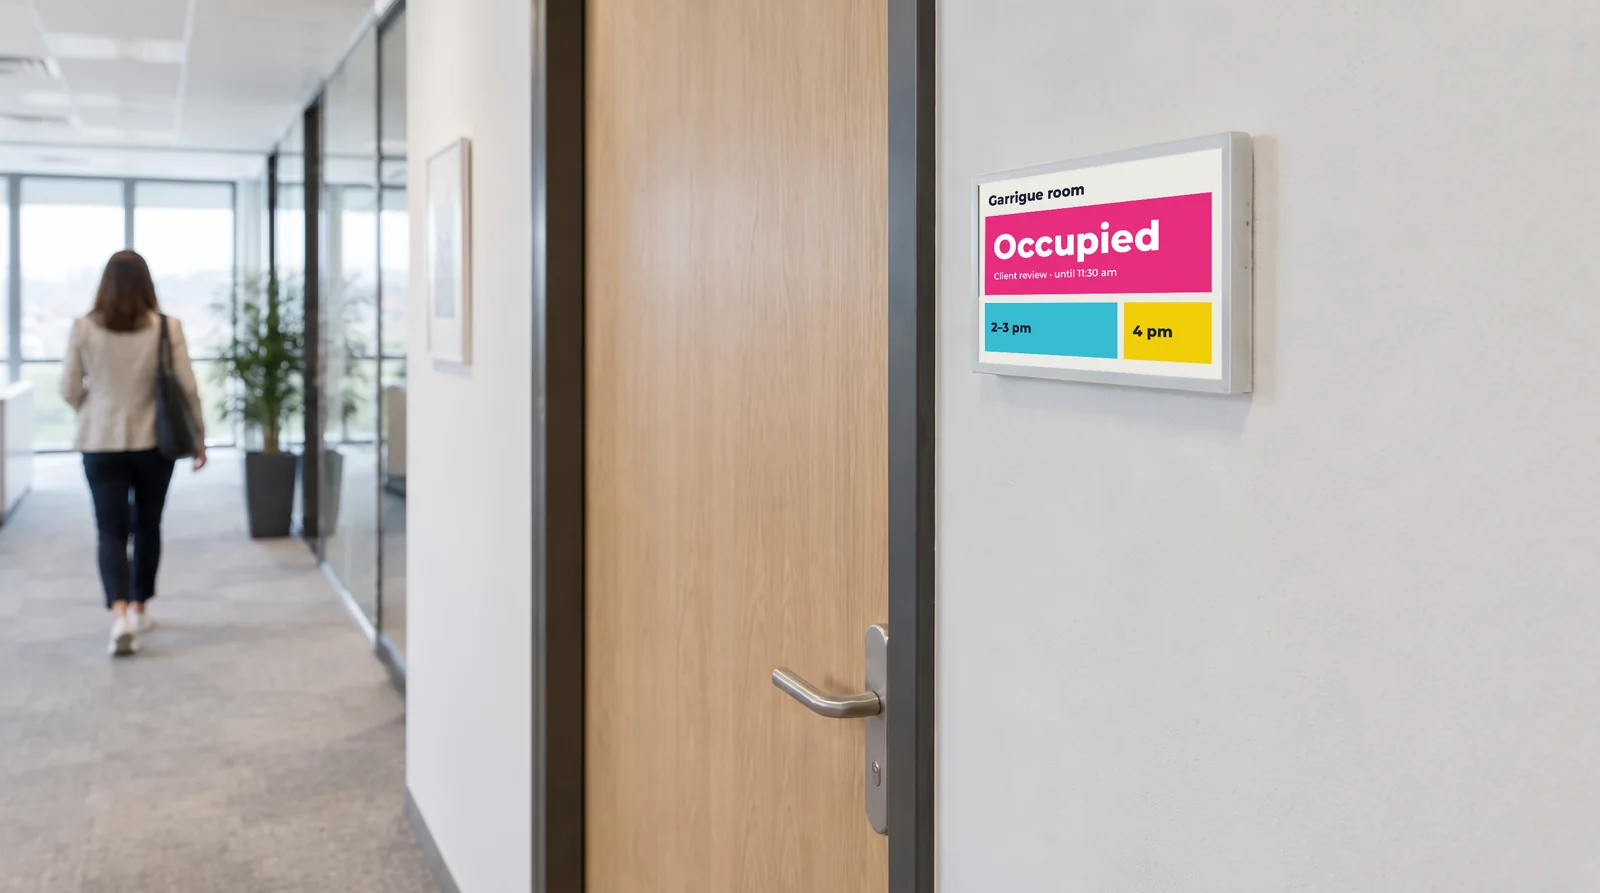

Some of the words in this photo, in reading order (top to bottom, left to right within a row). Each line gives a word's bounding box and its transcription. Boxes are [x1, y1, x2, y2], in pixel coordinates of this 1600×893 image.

[988, 190, 1043, 206] Garrigue
[1047, 185, 1085, 199] room
[993, 219, 1160, 263] Occupied
[993, 271, 1018, 281] Client
[1019, 271, 1047, 280] review
[1054, 269, 1076, 279] until
[1077, 269, 1099, 278] 11:30
[1101, 269, 1117, 278] am
[1012, 324, 1032, 336] pm
[1132, 325, 1143, 337] 4
[1147, 327, 1173, 340] pm
